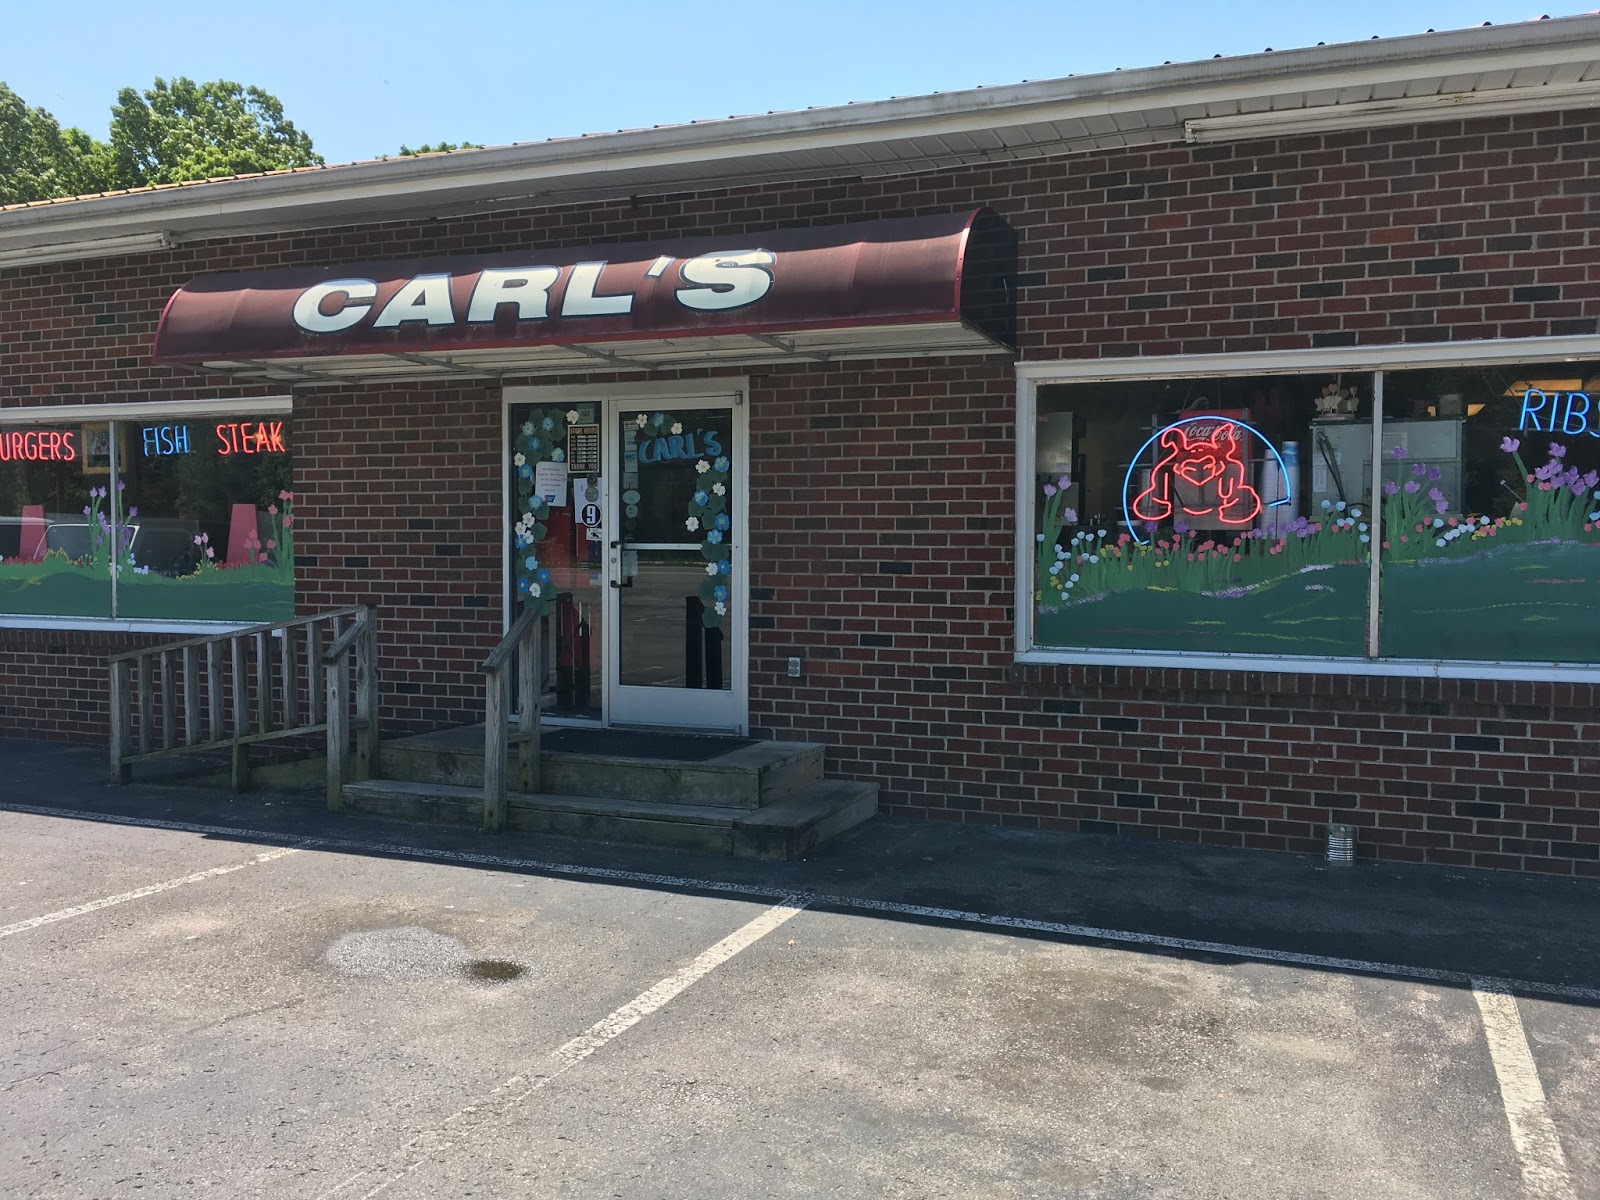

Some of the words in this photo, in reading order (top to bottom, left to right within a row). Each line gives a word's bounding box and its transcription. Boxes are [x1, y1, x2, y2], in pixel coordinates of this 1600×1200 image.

[291, 247, 778, 334] CARL'S
[142, 425, 190, 457] FISH
[215, 421, 286, 456] STEAK
[638, 428, 722, 464] CARL'S
